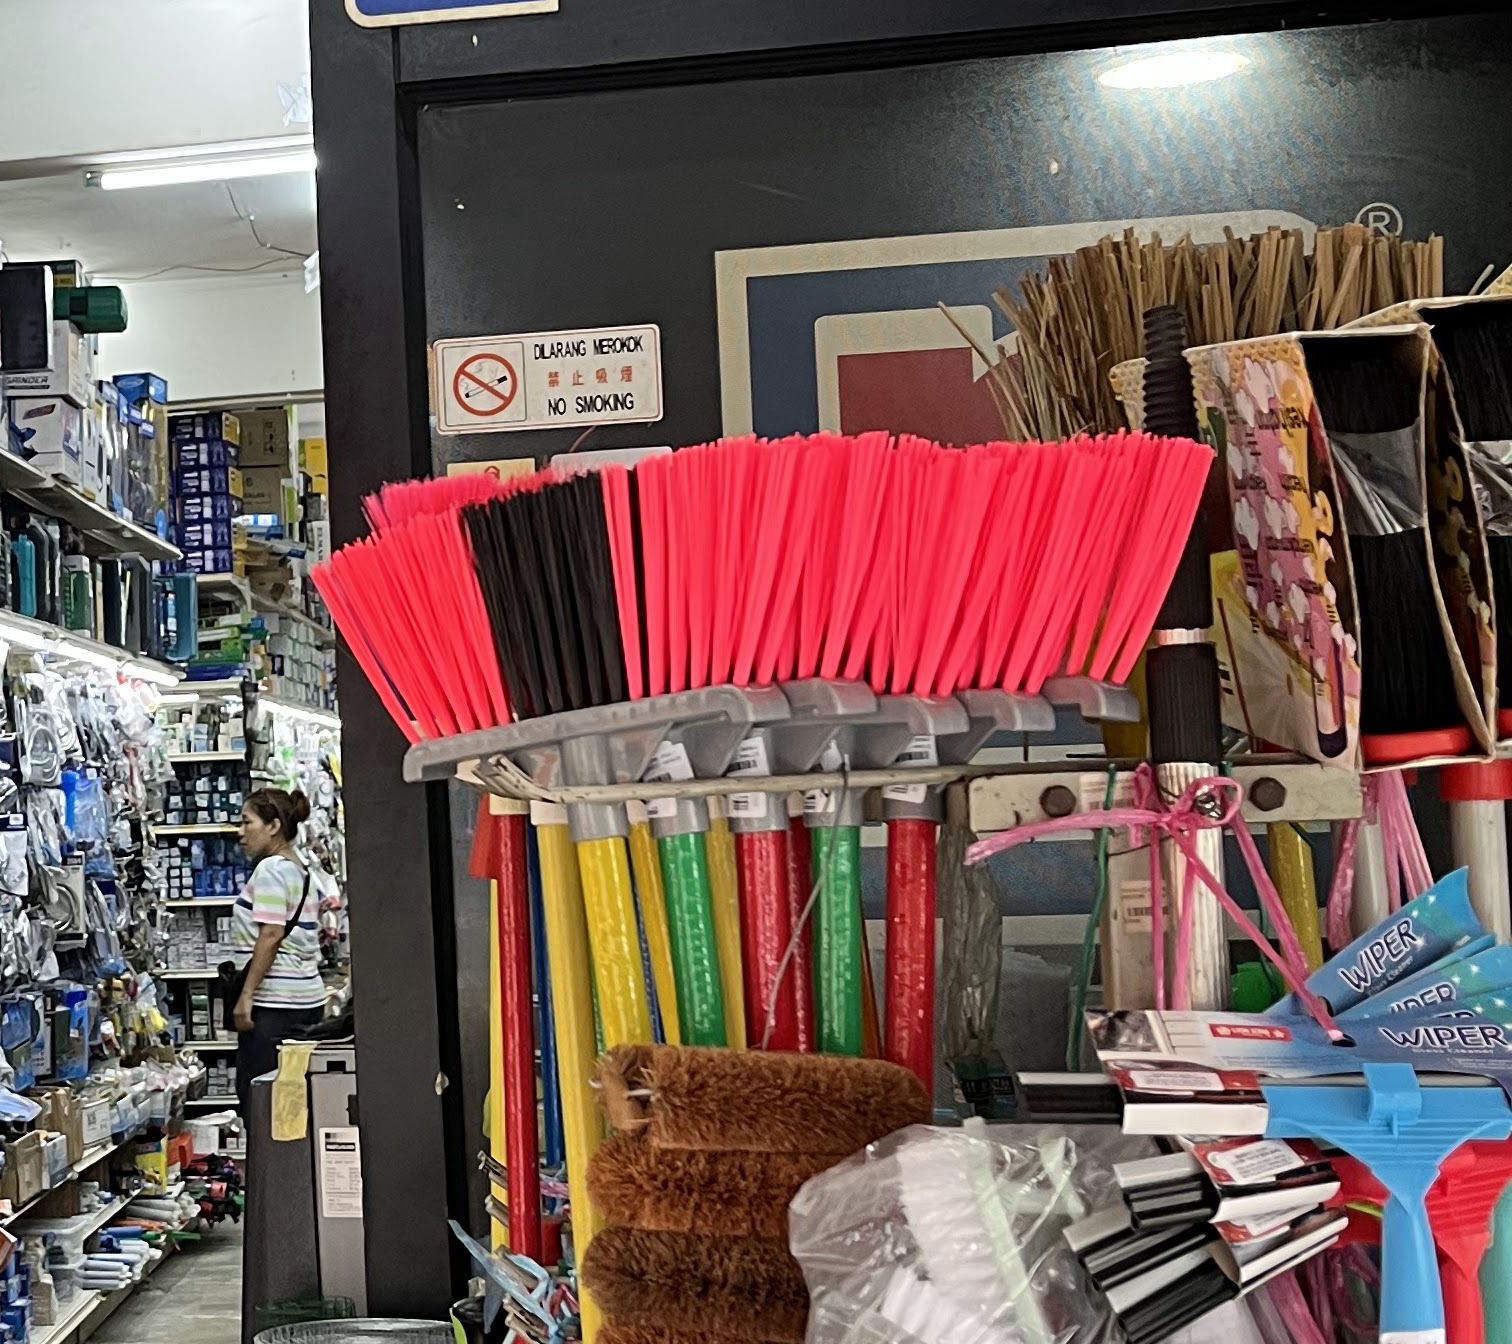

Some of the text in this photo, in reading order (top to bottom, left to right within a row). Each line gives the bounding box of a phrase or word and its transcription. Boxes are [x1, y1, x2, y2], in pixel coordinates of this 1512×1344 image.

[534, 335, 644, 361] DILARANG MEROKOK
[547, 392, 635, 417] NO SMOKING
[1339, 917, 1418, 993] WIPER
[1379, 1025, 1509, 1049] WIPER
